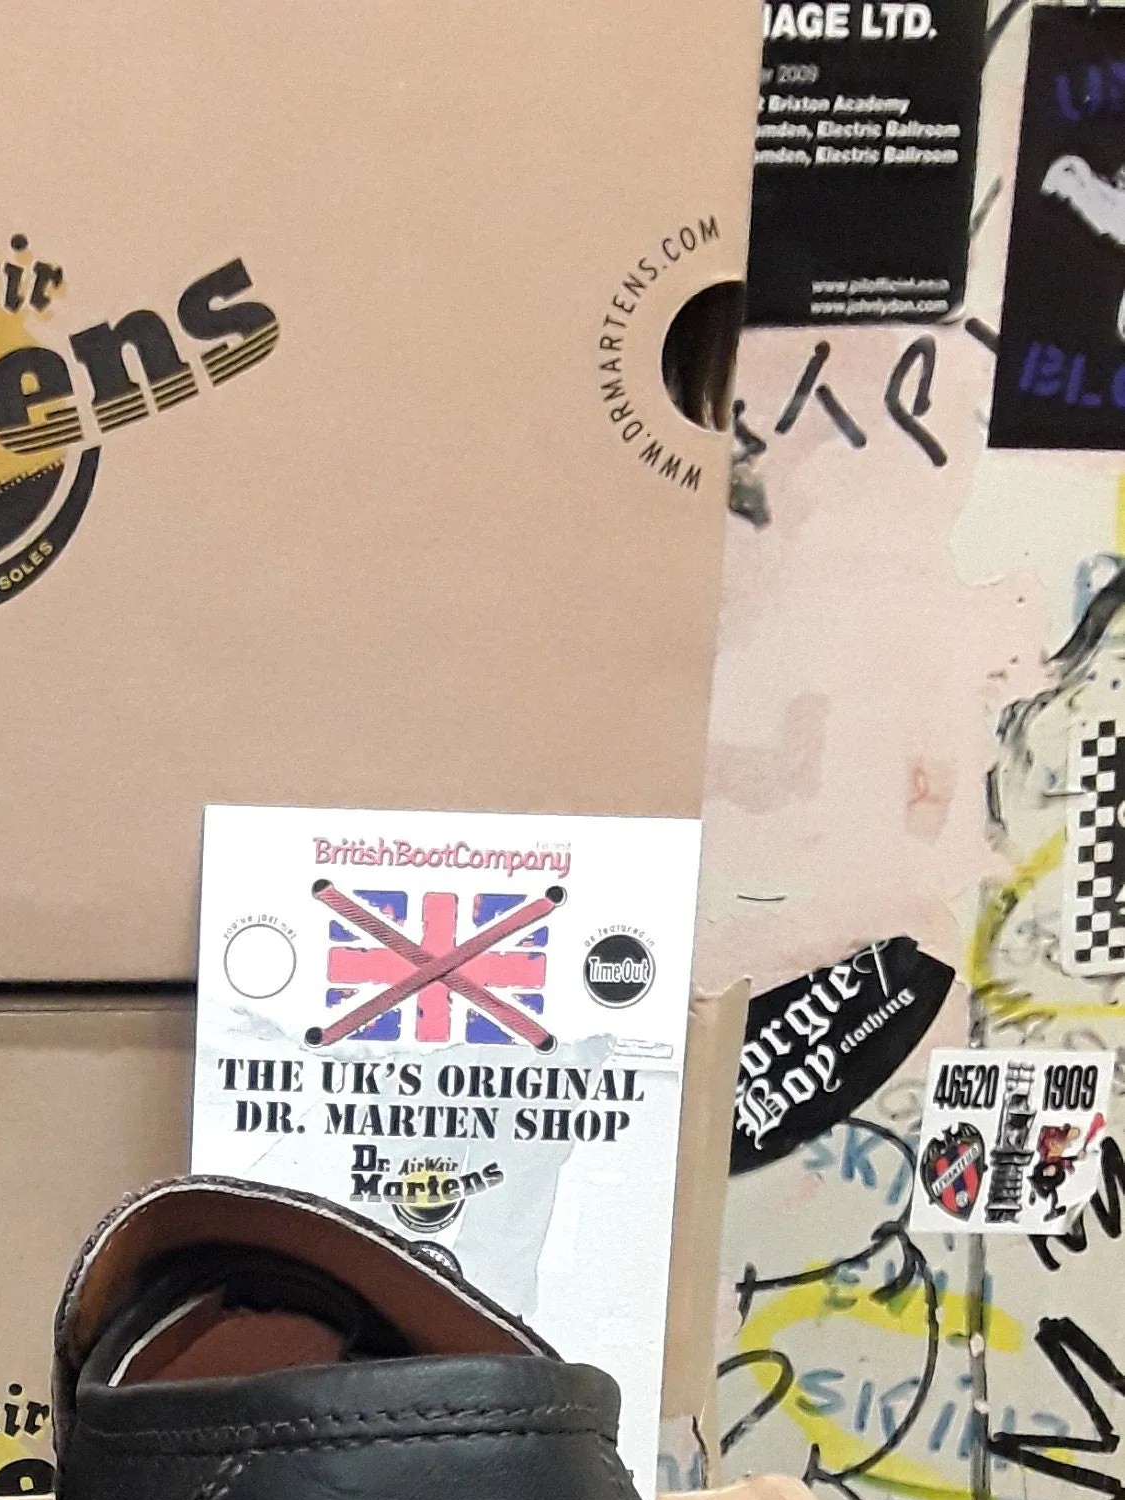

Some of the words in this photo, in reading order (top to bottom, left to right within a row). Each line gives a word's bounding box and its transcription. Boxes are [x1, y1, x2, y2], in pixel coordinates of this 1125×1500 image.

[861, 3, 938, 41] LTD.
[832, 95, 911, 116] Academy
[885, 120, 961, 139] Ballroom
[883, 146, 959, 165] Ballroom
[598, 214, 720, 493] WWW.DRMARTENS.COM
[313, 838, 571, 879] BritishBootCompany
[740, 964, 863, 1079] orgie
[218, 1058, 303, 1093] THE
[321, 1061, 423, 1097] UK'S
[437, 1063, 645, 1102] ORIGINAL
[735, 1043, 842, 1150] Boy
[932, 1064, 1000, 1109] 46520
[1043, 1065, 1098, 1111] 1909
[235, 1100, 306, 1134] DR.
[324, 1103, 500, 1140] MARTEN
[513, 1108, 631, 1142] SHOP
[351, 1144, 390, 1172] Dr.
[398, 1156, 458, 1176] AirWair
[350, 1162, 504, 1202] Martens
